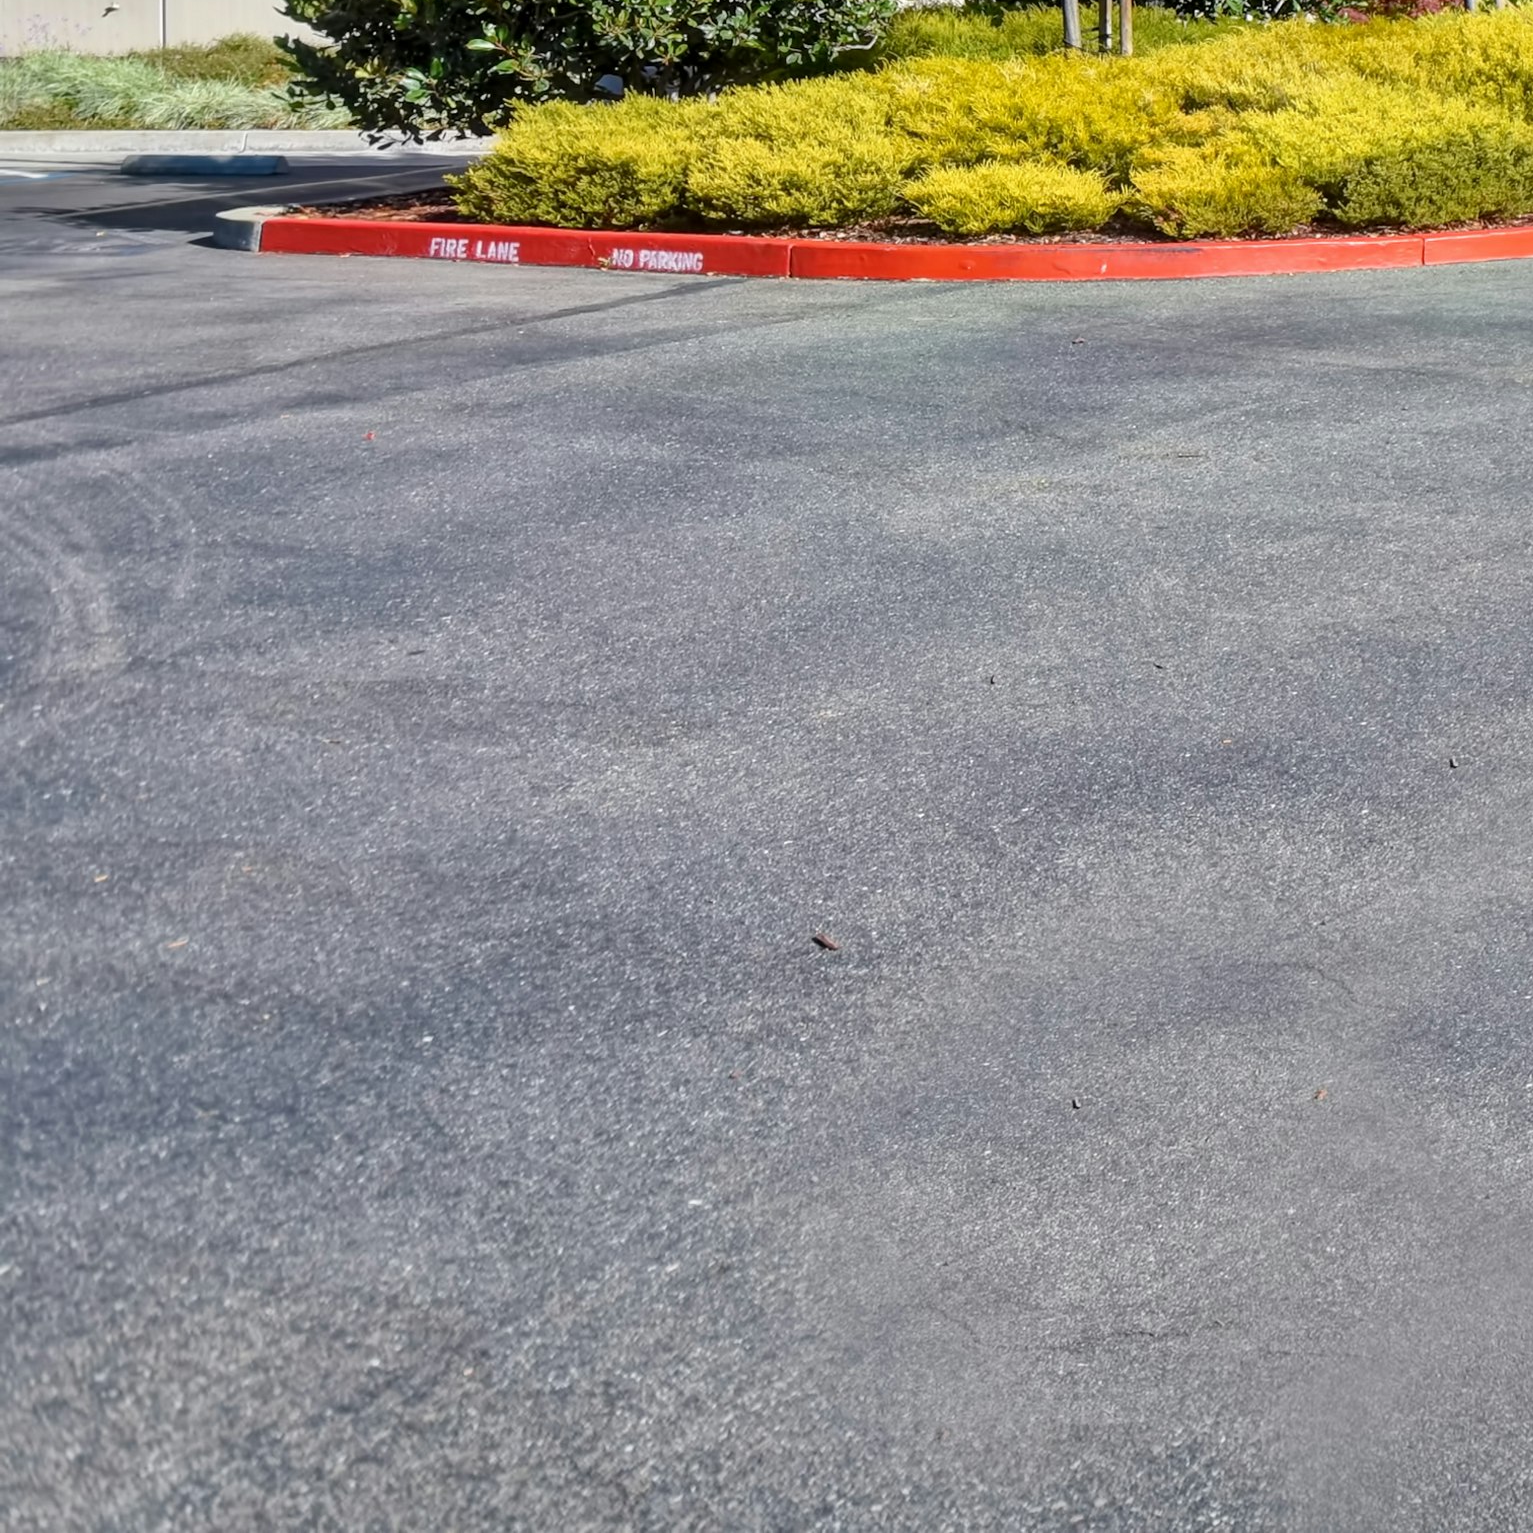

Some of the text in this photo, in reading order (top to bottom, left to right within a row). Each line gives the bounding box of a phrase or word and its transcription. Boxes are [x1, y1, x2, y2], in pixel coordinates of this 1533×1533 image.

[430, 237, 520, 262] FIRE LANE
[612, 248, 703, 271] NO PARKING
